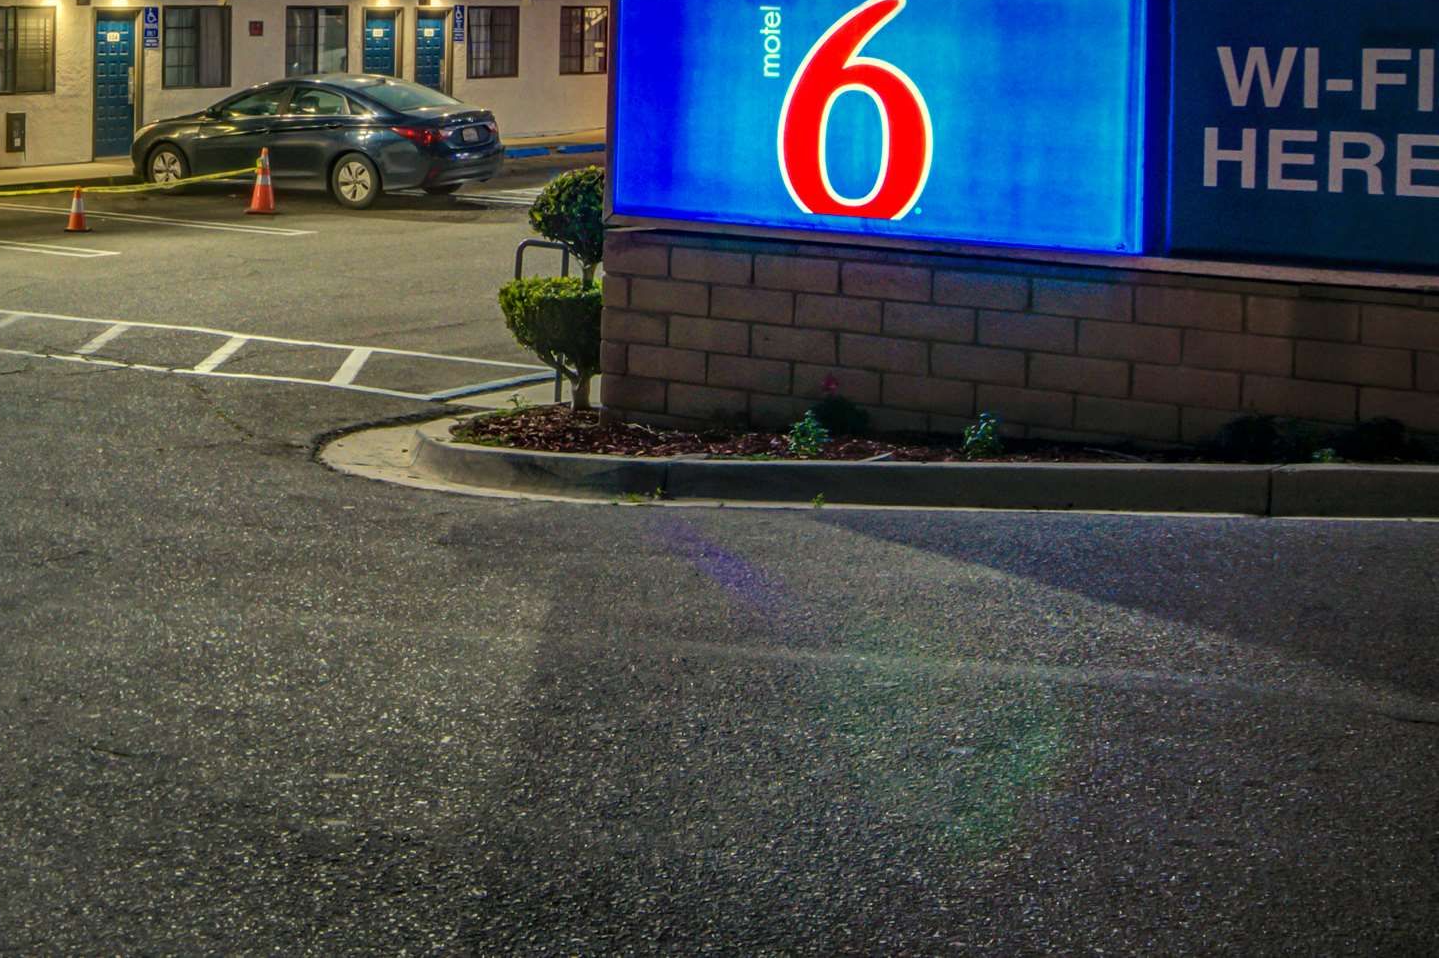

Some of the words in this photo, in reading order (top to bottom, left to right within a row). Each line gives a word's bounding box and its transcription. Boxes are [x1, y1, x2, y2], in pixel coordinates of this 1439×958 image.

[759, 5, 782, 78] motel
[1215, 46, 1435, 112] WI-FI
[1203, 126, 1439, 198] HERE
